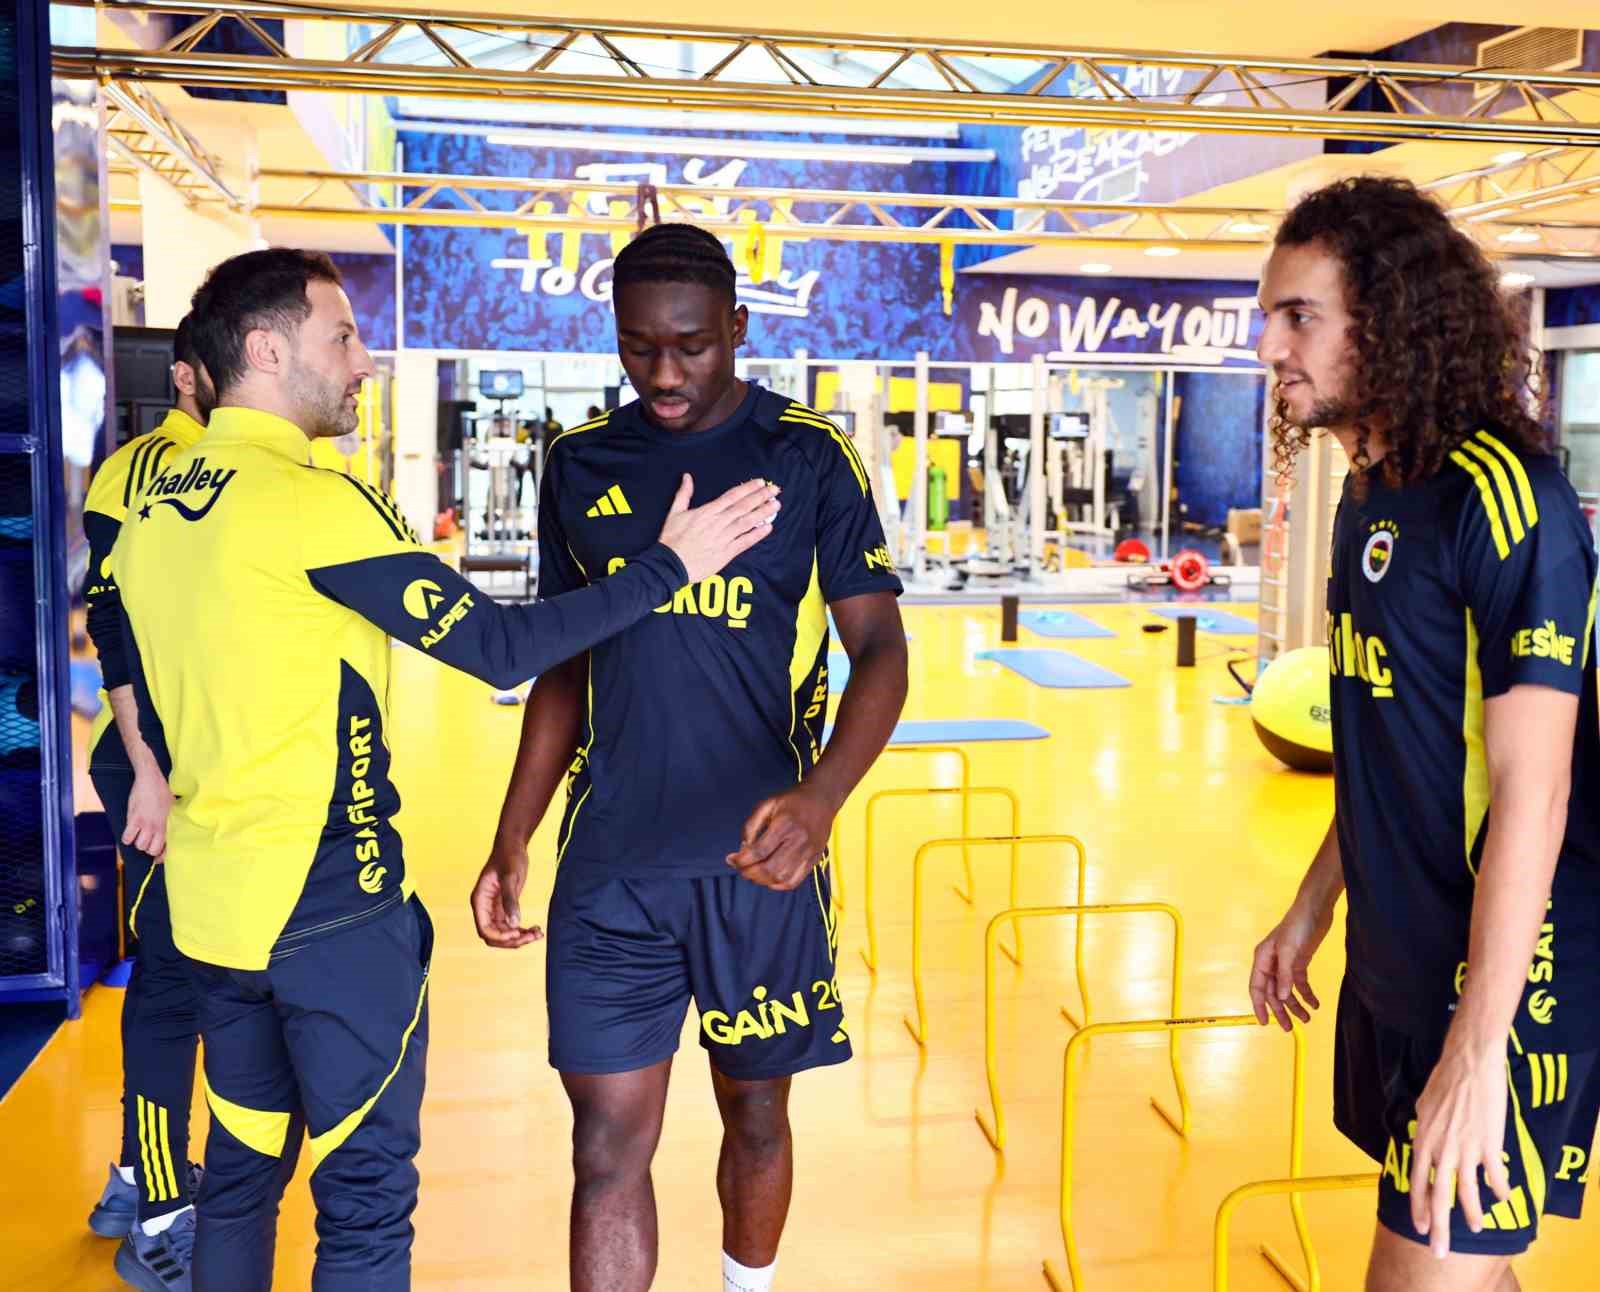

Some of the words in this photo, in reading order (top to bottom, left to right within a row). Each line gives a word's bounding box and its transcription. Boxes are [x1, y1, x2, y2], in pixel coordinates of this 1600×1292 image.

[977, 287, 1050, 353] NO
[1059, 297, 1182, 353] WAY
[1182, 296, 1260, 347] OUT
[145, 457, 237, 521] halley
[419, 592, 476, 650] ALPET
[701, 985, 810, 1045] GAİN
